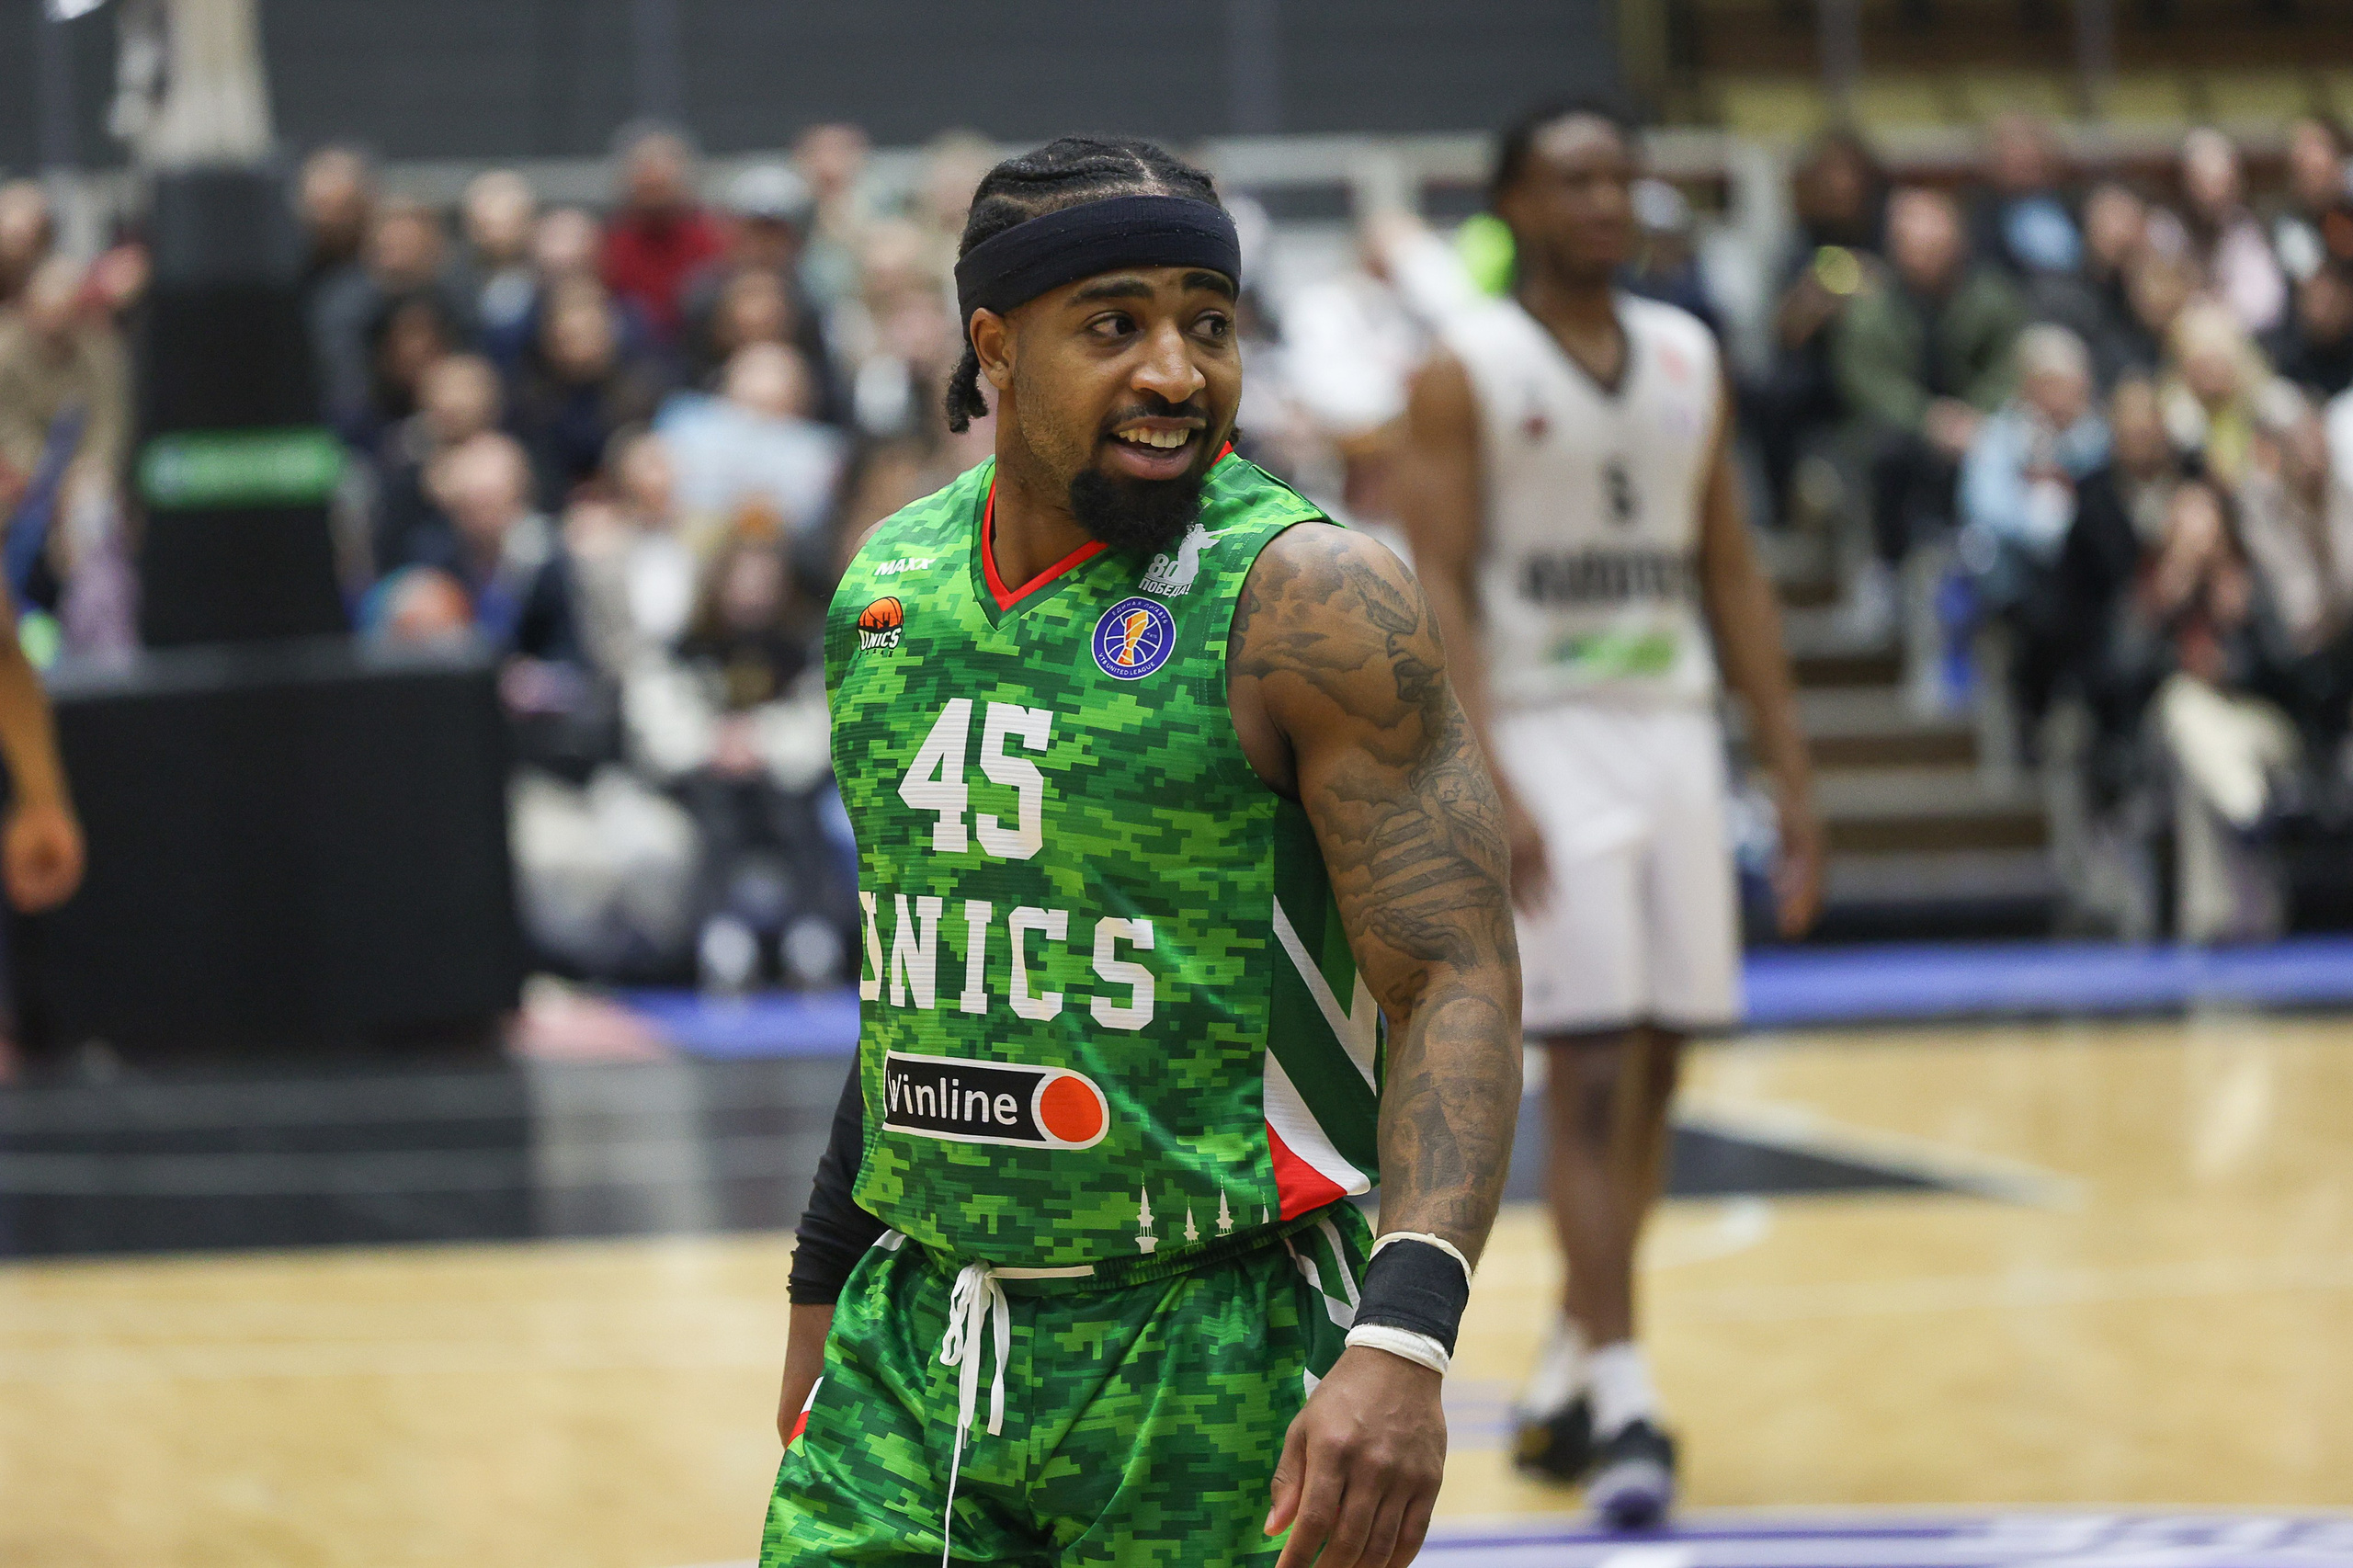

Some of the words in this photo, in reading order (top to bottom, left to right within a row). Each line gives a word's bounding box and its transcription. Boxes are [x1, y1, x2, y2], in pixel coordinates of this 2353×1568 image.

[874, 558, 936, 575] MAXX
[1148, 553, 1179, 578] 80
[1138, 577, 1192, 598] ПОБЕДА!
[858, 628, 902, 651] UNICS
[1098, 653, 1108, 665] VTB
[1106, 664, 1129, 676] UNITED
[1131, 662, 1155, 676] LEAGUE
[898, 698, 1053, 860] 45
